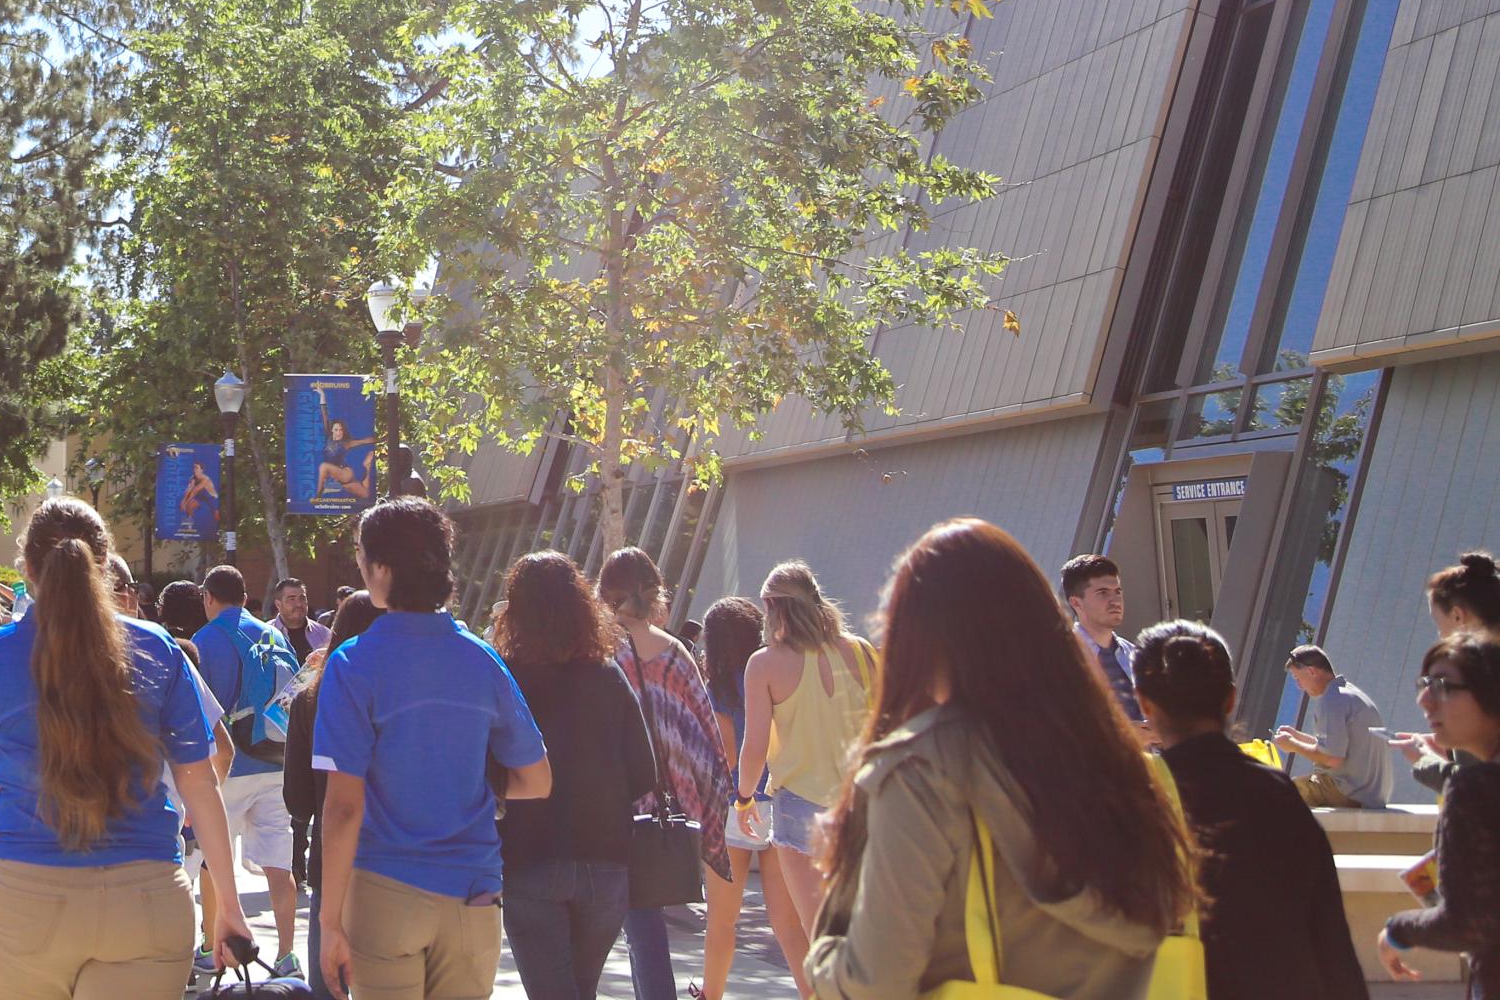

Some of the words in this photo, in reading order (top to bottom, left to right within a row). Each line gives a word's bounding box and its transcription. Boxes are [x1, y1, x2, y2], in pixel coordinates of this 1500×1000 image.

[298, 391, 315, 500] GYMNASTICS
[164, 456, 179, 526] VOLLEYBALL
[1176, 484, 1206, 500] SERVICE
[1207, 480, 1245, 497] ENTRANCE
